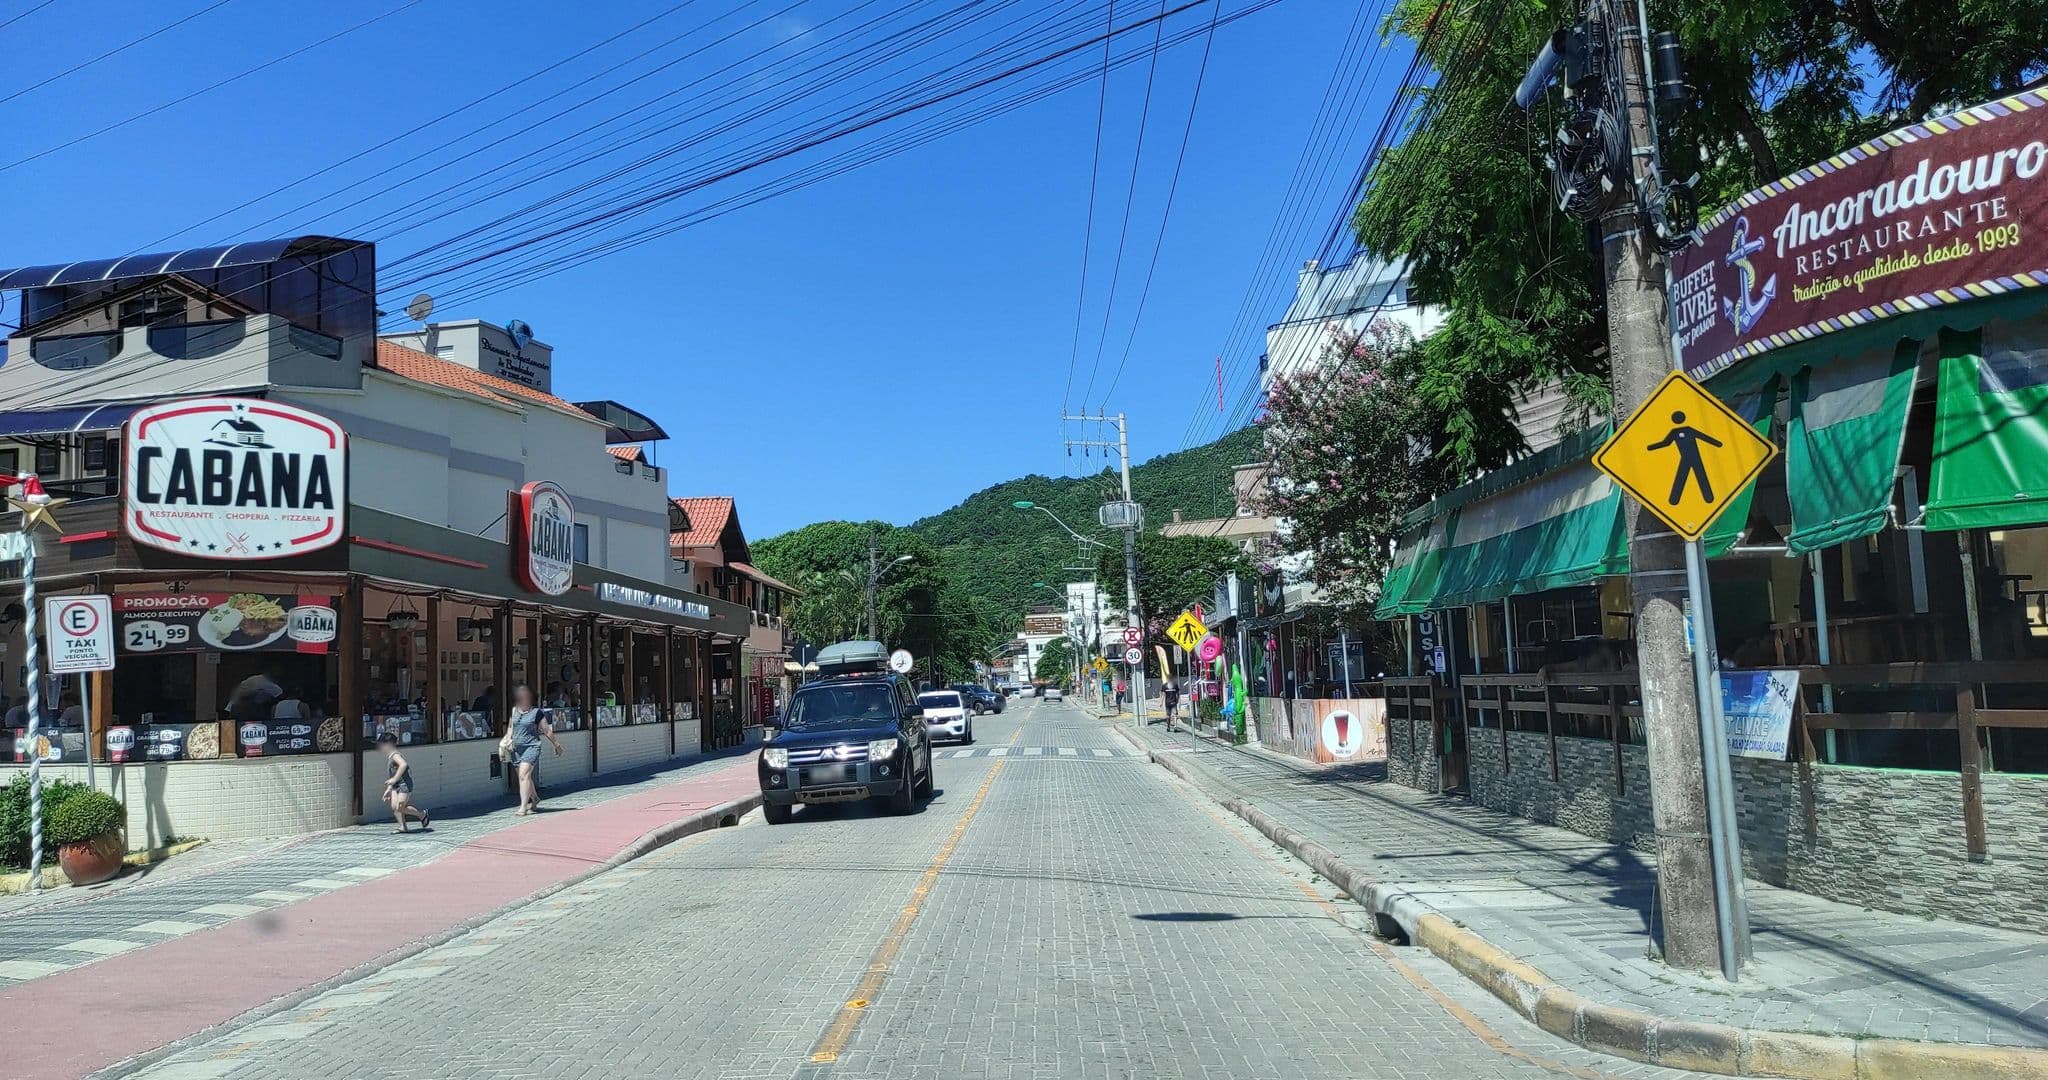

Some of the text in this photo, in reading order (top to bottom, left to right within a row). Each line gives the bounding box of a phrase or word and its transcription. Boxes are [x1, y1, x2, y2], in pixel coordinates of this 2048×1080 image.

[1773, 141, 2048, 258] Ancoradouro
[1796, 197, 2008, 276] RESTAURANTE
[1673, 260, 1715, 303] BUFFET
[1792, 223, 2021, 303] tradição e qualidade desde 1993
[1675, 283, 1718, 331] LIVRE
[1691, 314, 1716, 347] pessoa
[137, 446, 334, 510] CABANA
[149, 511, 214, 520] RESTAURANTE
[225, 512, 270, 521] CHOPERIA
[532, 512, 572, 564] CABANA
[72, 610, 86, 629] E
[124, 595, 209, 610] PROMOÇÃO
[124, 610, 201, 619] ALMOÇO EXECUTIVO
[1127, 652, 1140, 660] 30
